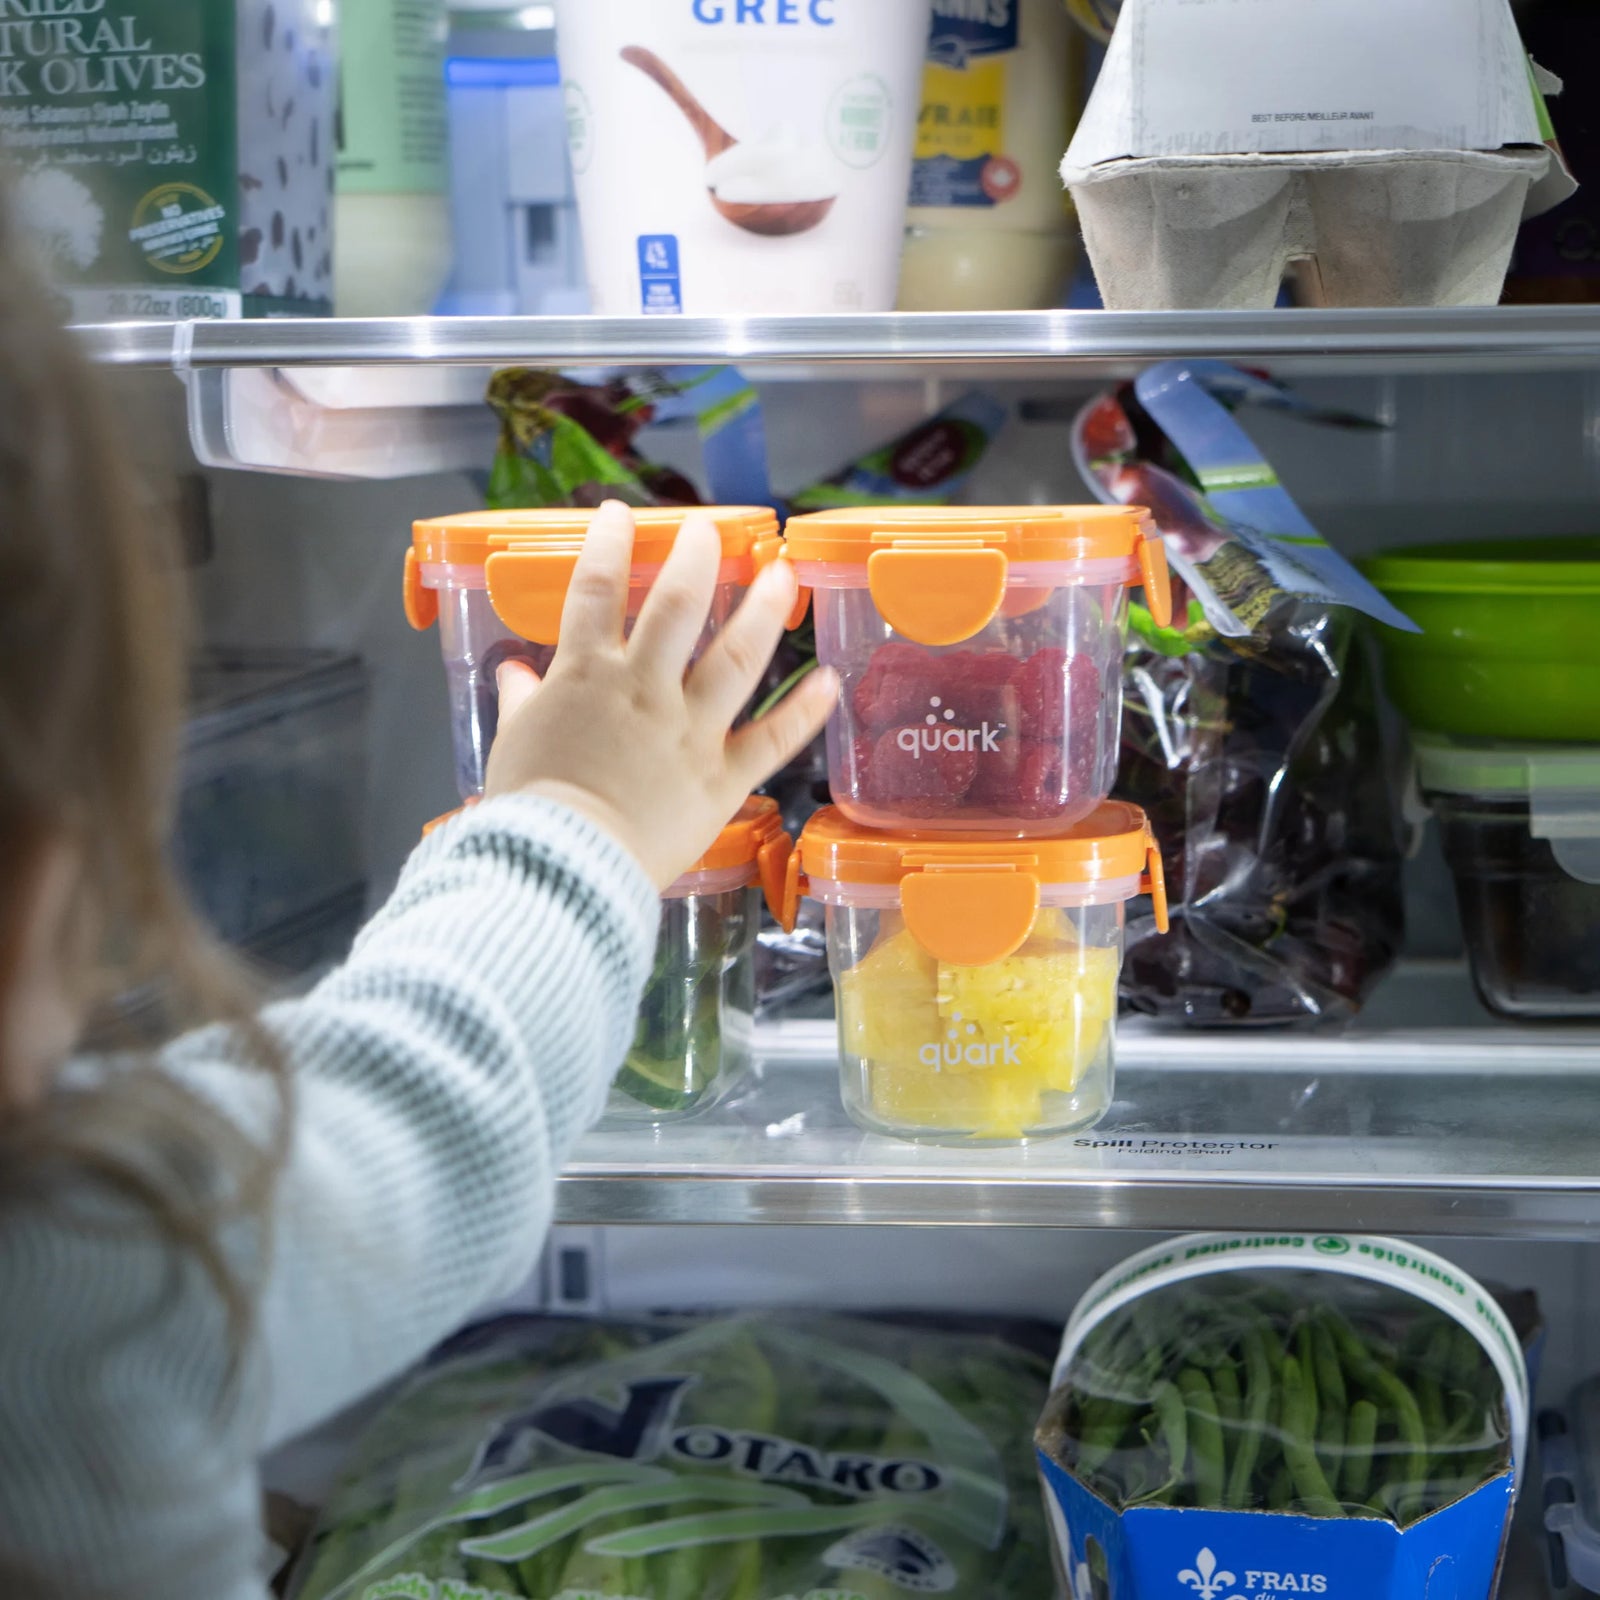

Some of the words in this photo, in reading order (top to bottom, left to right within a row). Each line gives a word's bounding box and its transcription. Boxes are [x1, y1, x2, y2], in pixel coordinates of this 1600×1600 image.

[692, 0, 835, 26] GREC
[0, 17, 152, 57] TURAL
[40, 53, 206, 96] OLIVES
[1251, 114, 1272, 123] BEST
[1349, 111, 1375, 120] AVANT
[1073, 1139, 1133, 1149] Spill
[1141, 1139, 1280, 1150] Protector
[1186, 1148, 1232, 1156] Shelf
[1244, 1570, 1328, 1593] FRAIS
